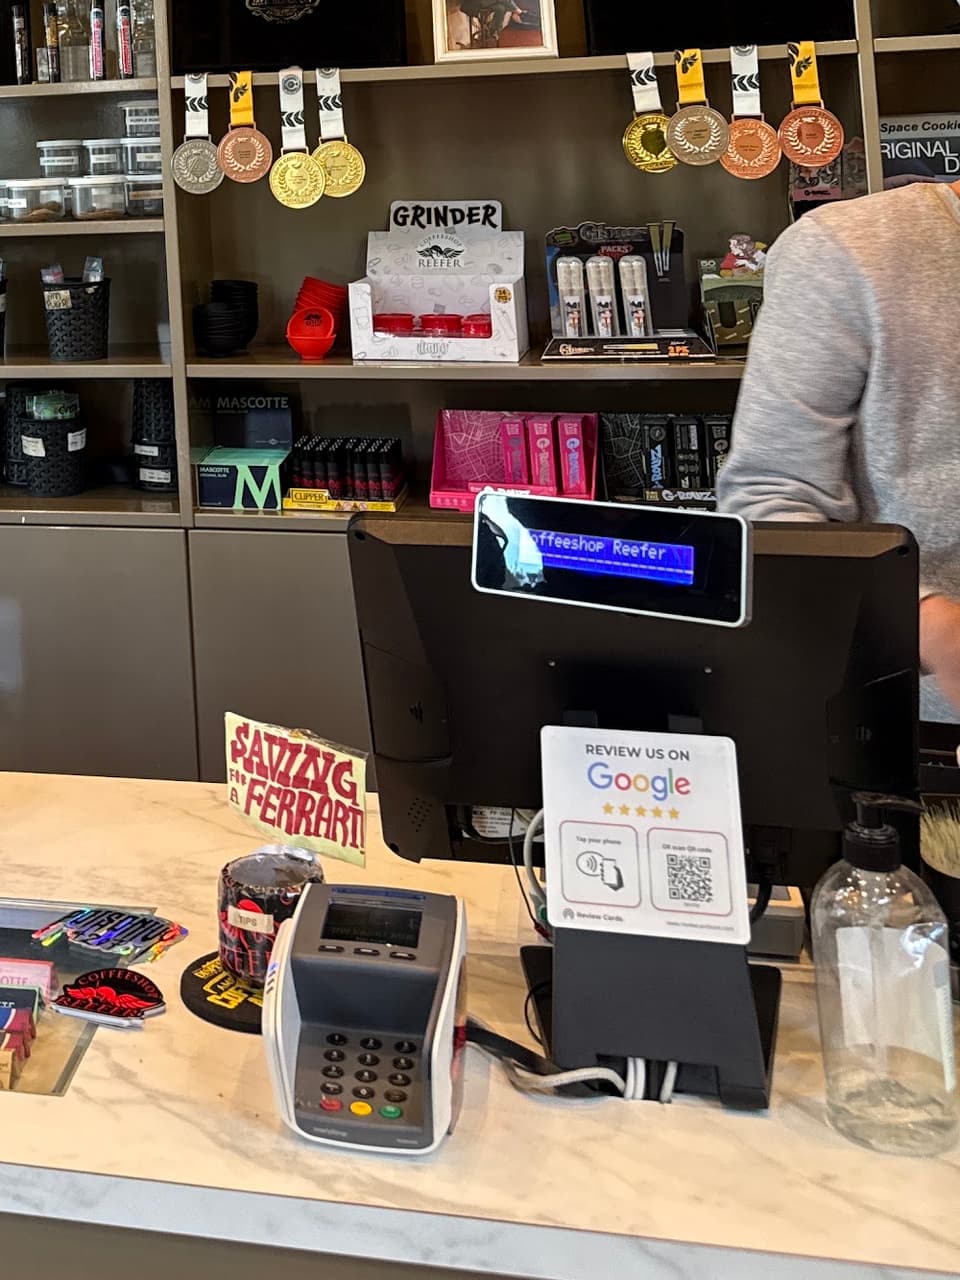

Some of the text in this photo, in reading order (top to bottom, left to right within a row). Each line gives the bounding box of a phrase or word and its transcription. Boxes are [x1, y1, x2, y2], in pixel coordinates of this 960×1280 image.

[881, 123, 918, 133] Space
[393, 205, 498, 229] GRINDER
[418, 259, 462, 268] REEFER
[217, 397, 288, 409] MASCOTTE
[294, 492, 324, 502] CLIPPER
[613, 539, 666, 560] Reefer
[586, 744, 690, 761] REVIEW US ON
[230, 722, 360, 807] SAVING
[587, 762, 691, 801] Google
